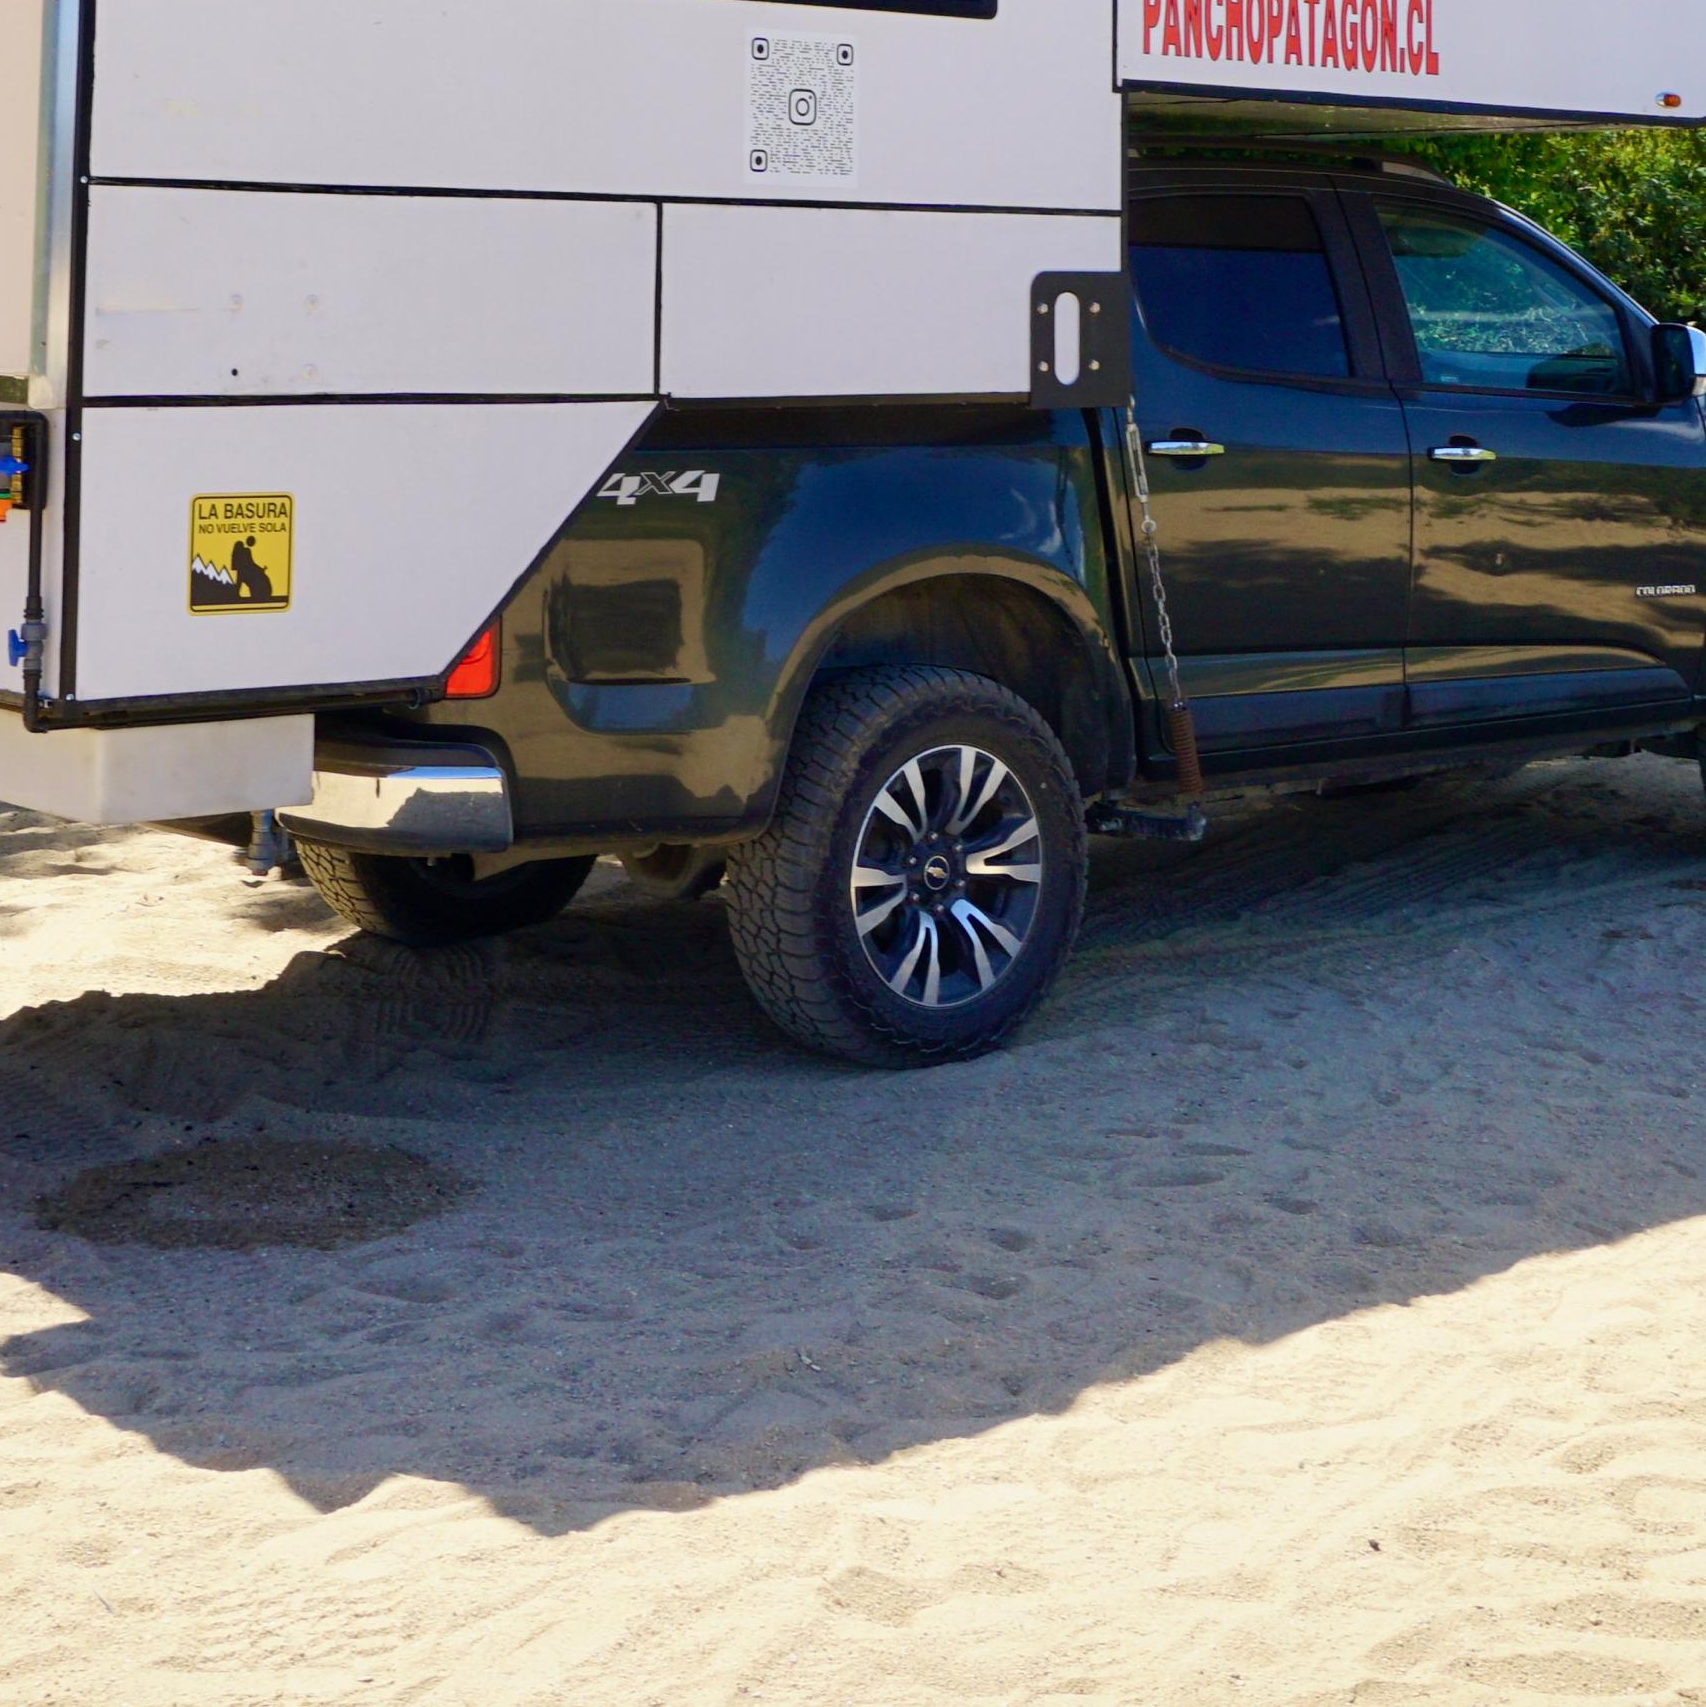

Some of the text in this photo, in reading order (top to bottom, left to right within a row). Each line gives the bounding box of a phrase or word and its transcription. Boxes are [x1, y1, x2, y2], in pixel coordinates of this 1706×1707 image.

[198, 502, 288, 519] LA BASURA
[198, 522, 286, 534] NO VUELVE SOLA
